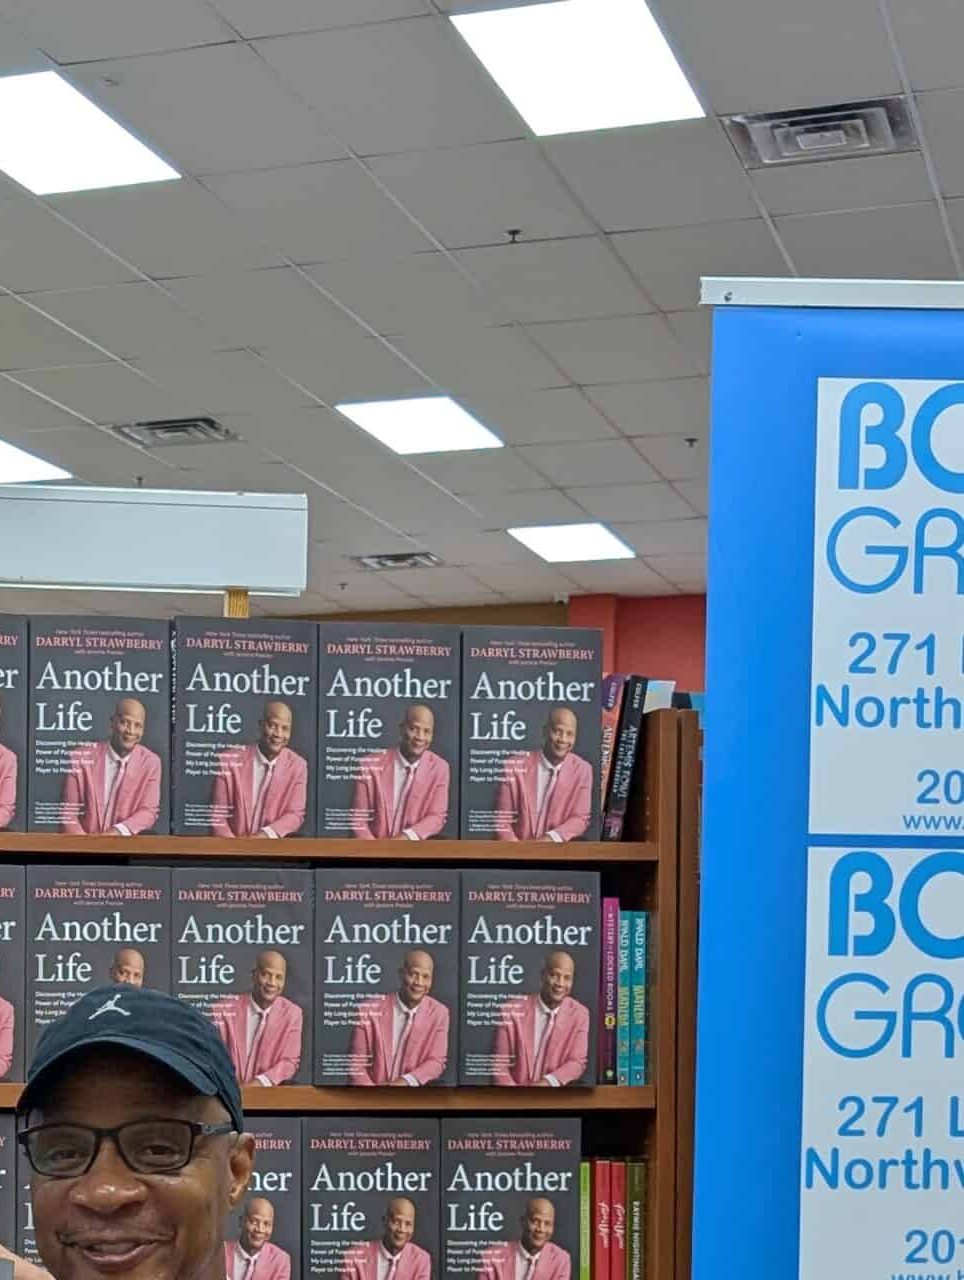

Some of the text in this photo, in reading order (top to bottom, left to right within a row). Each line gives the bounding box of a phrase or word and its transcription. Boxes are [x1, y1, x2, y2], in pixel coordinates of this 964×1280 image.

[36, 636, 163, 650] DARRYL STRAWBERRY
[186, 638, 309, 654] DARRYL STRAWBERRY
[326, 643, 451, 657] DARRYL STRAWBERRY
[471, 647, 594, 660] DARRYL STRAWBERRY
[848, 631, 935, 675] 271
[36, 661, 163, 692] Another
[186, 663, 310, 696] Another
[326, 668, 451, 698] Another
[470, 672, 595, 702] Another
[36, 701, 93, 731] Life
[186, 703, 242, 734] Life
[815, 684, 962, 728] North
[326, 708, 383, 738] Life
[470, 711, 526, 740] Life
[916, 769, 964, 805] 20
[35, 887, 162, 900] DARRYL STRAWBERRY
[178, 890, 303, 902] DARRYL STRAWBERRY
[324, 890, 452, 902] DARRYL STRAWBERRY
[469, 891, 591, 904] DARRYL STRAWBERRY
[828, 851, 964, 960] BO
[36, 911, 162, 943] Another
[178, 914, 305, 945] Another
[324, 914, 452, 945] Another
[468, 915, 592, 945] Another
[36, 952, 92, 983] Life
[178, 954, 235, 985] Life
[324, 954, 381, 985] Life
[468, 955, 525, 984] Life
[837, 1095, 924, 1137] 271
[310, 1139, 430, 1150] DARRYL STRAWBERRY
[448, 1139, 572, 1150] DARRYL STRAWBERRY
[310, 1162, 432, 1192] Another
[447, 1162, 572, 1192] Another
[310, 1202, 366, 1232] Life
[447, 1202, 505, 1232] Life
